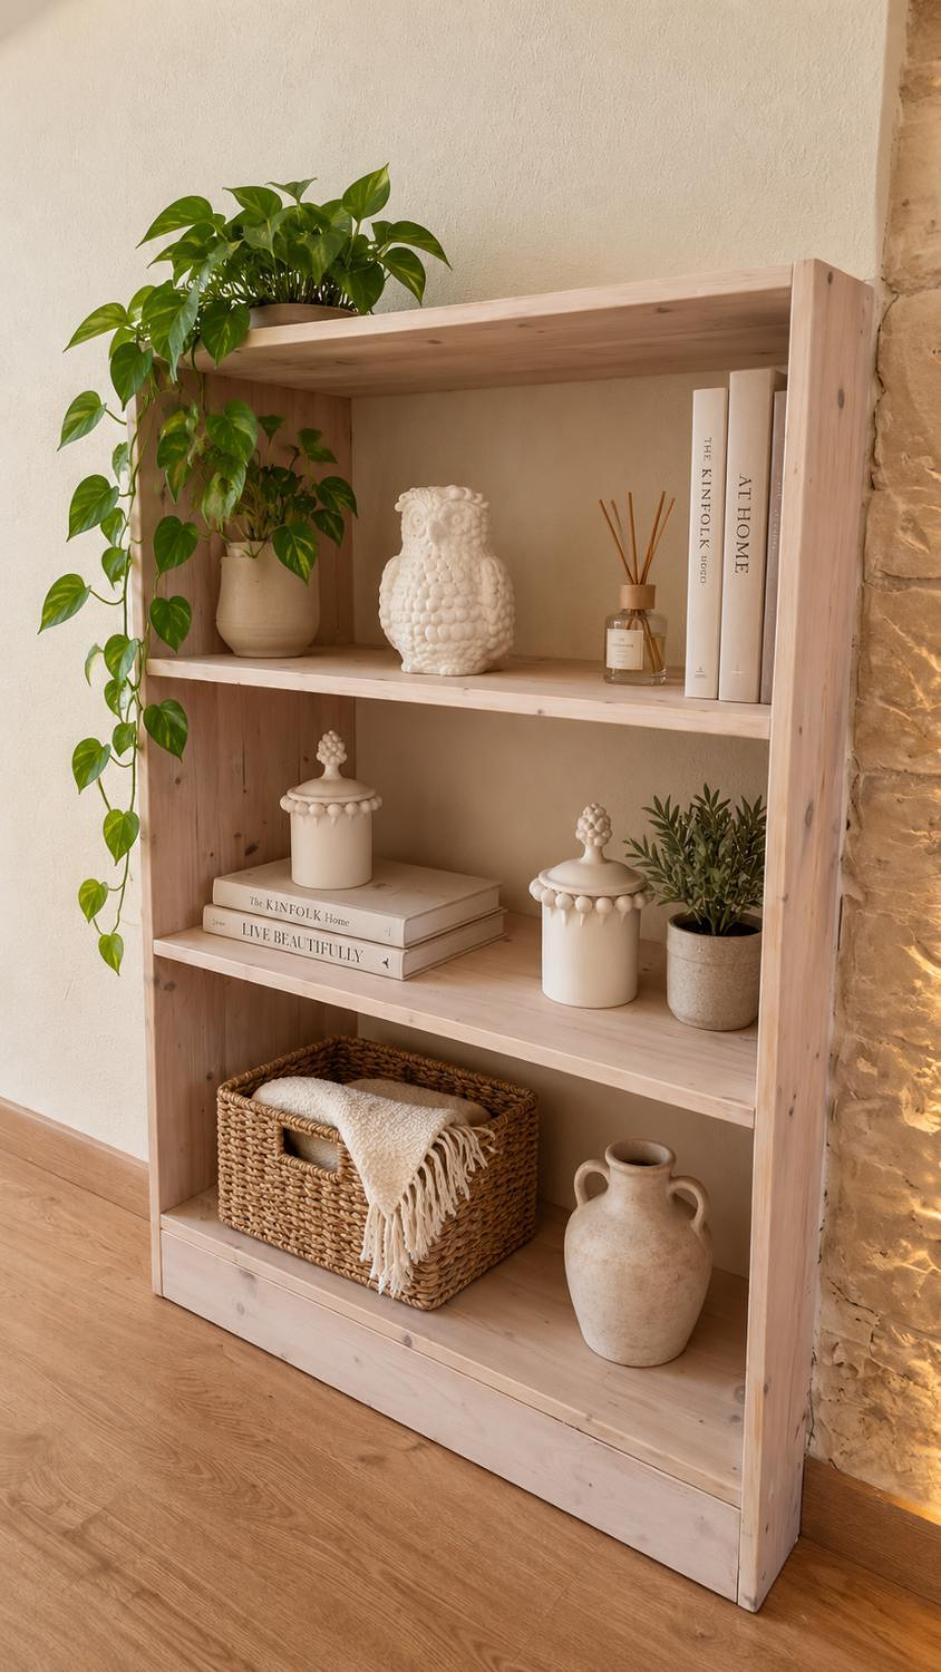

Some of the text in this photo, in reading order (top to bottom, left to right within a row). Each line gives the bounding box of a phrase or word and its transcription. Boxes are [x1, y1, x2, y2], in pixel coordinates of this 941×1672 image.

[704, 437, 712, 461] THE
[699, 468, 712, 550] KINFOLK
[734, 474, 752, 574] AT HOME
[249, 895, 350, 927] The KINFOLK Home
[242, 922, 364, 963] LIVE BEAUTIFULLY
